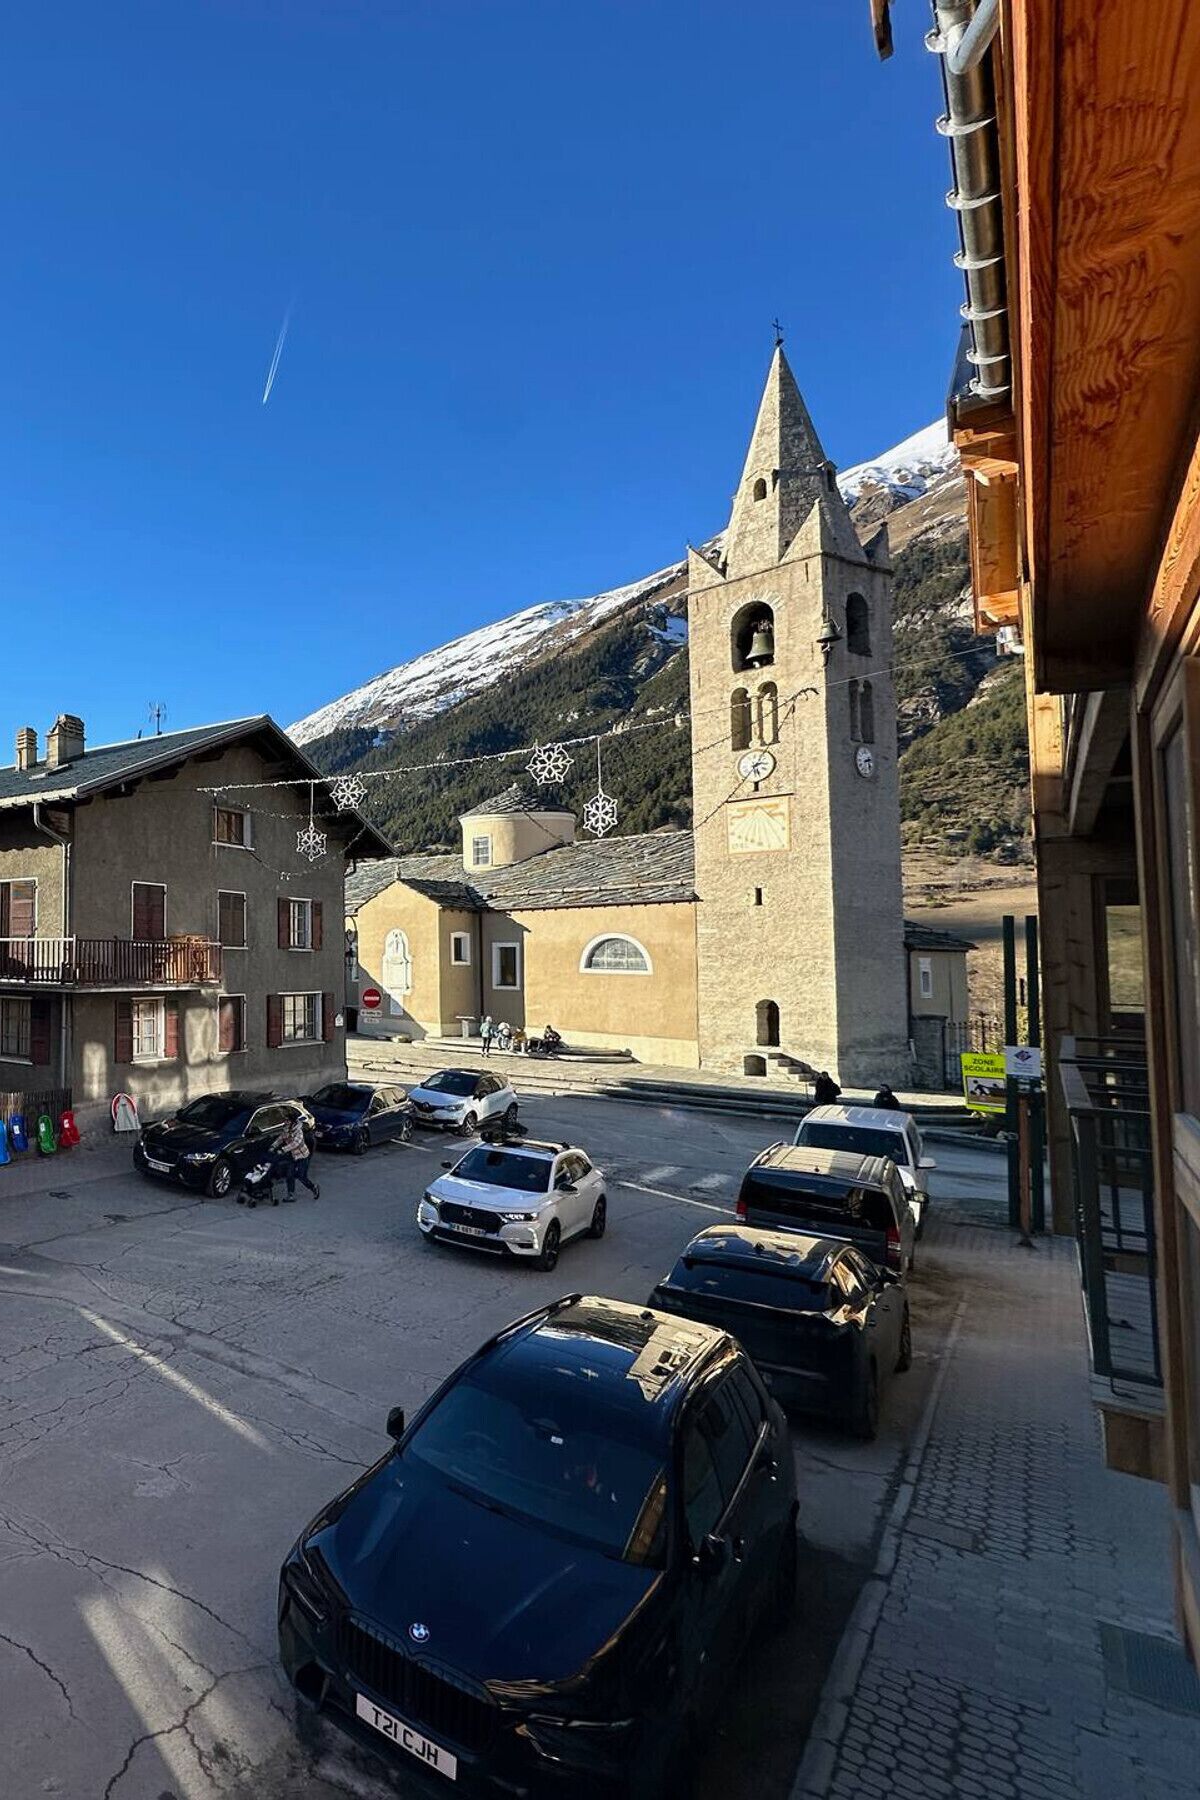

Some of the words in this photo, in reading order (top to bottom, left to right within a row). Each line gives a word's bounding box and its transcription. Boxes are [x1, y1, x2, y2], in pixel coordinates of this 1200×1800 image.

[972, 1058, 994, 1066] ZONE
[964, 1065, 1004, 1073] SCOLAIRE
[371, 1706, 398, 1740] T21
[402, 1727, 439, 1767] CJH
